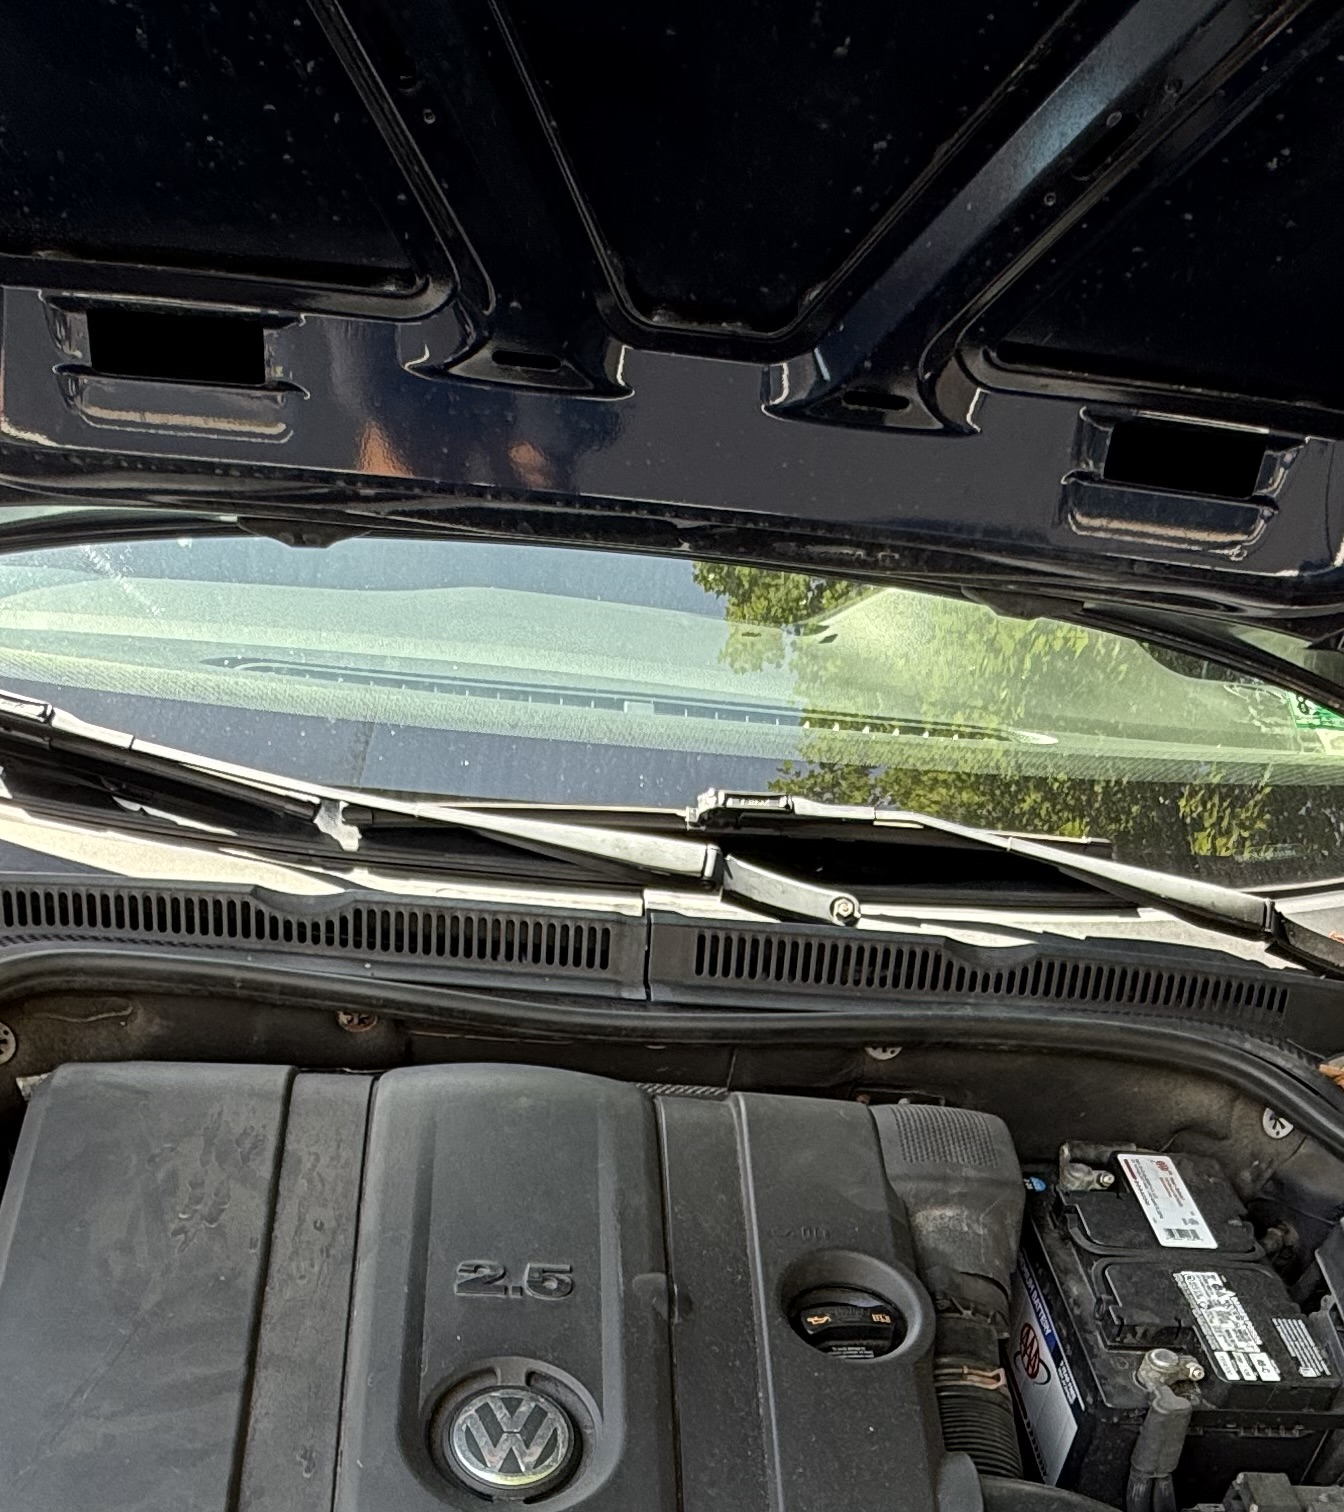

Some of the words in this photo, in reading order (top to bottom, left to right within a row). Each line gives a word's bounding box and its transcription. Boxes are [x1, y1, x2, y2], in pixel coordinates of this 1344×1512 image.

[454, 1259, 574, 1301] 2.5
[1030, 1288, 1052, 1336] BATTERY
[1020, 1323, 1040, 1379] AAA
[455, 1390, 568, 1483] VW
